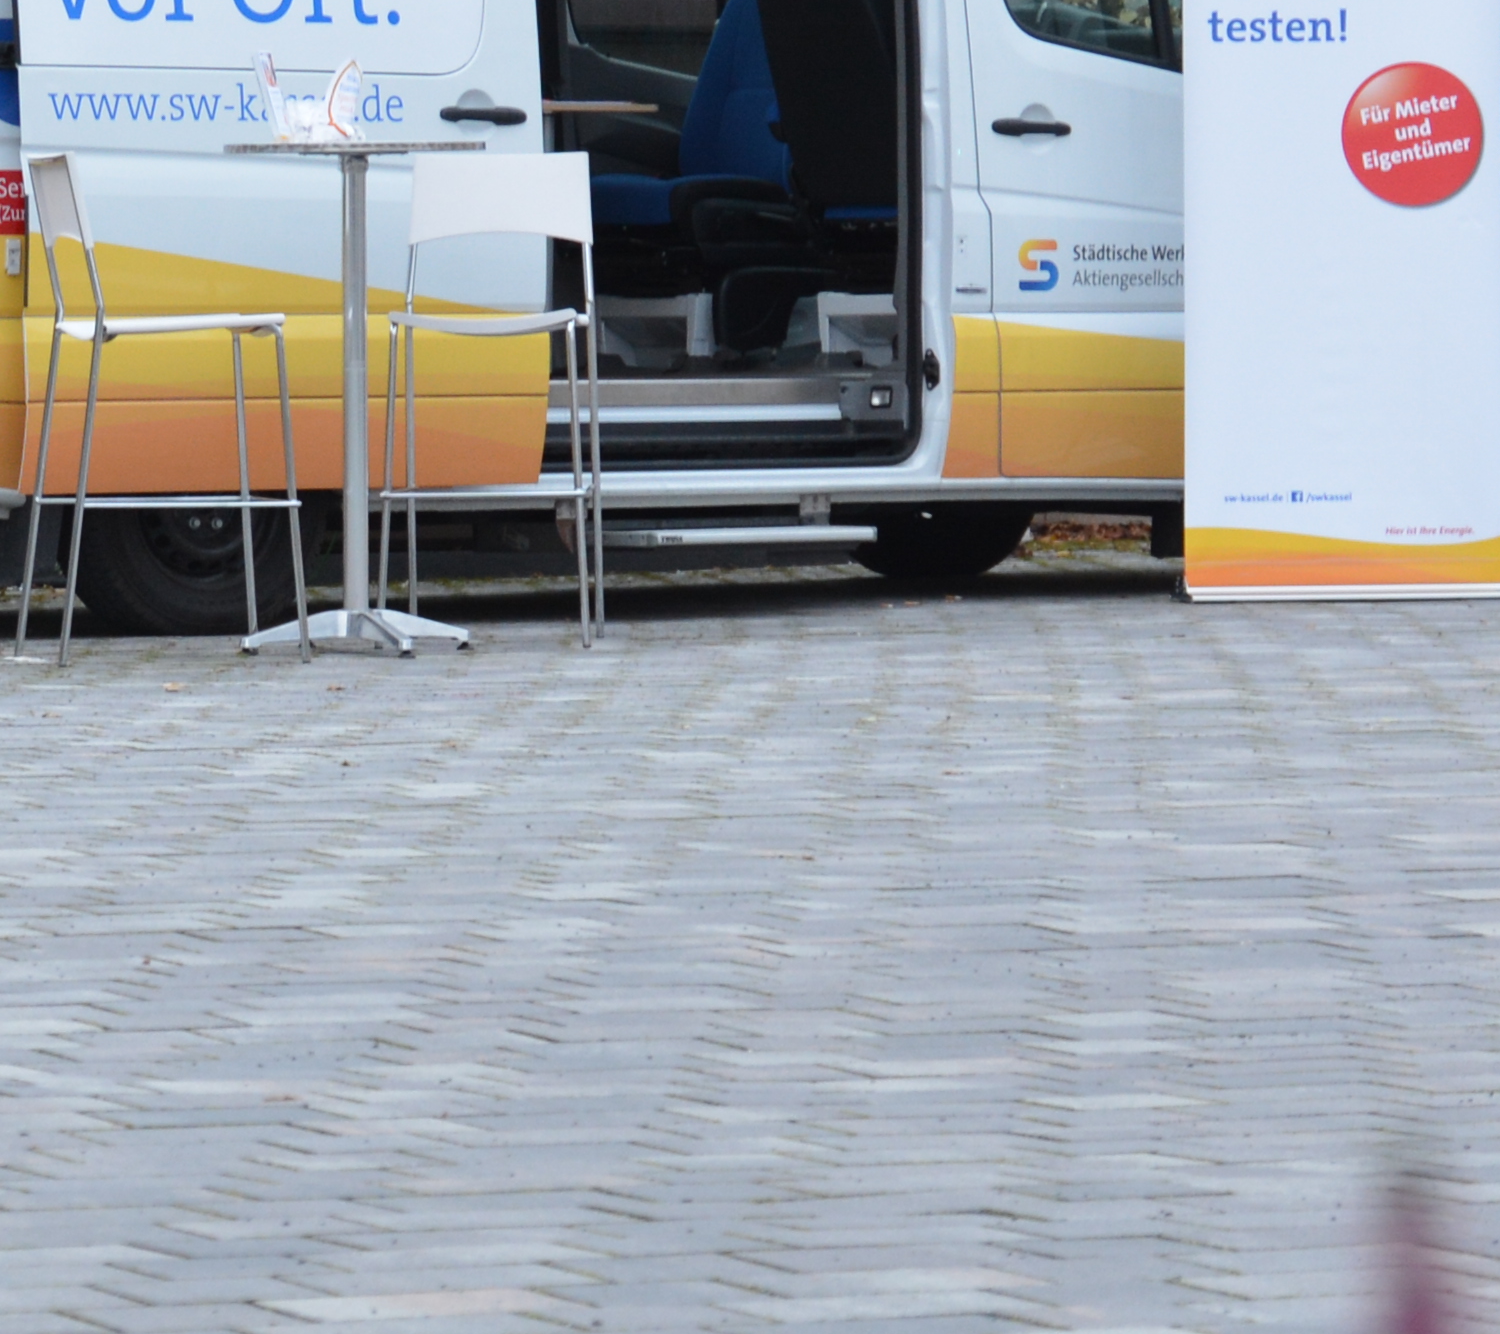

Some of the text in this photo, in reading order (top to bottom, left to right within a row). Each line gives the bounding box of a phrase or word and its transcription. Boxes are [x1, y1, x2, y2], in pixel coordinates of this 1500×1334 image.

[1207, 8, 1348, 43] testen!
[48, 83, 404, 122] www.sw-k.de
[1360, 94, 1458, 126] Für Mieter
[1394, 117, 1432, 142] und
[1361, 136, 1471, 172] Eigentümer
[1073, 244, 1148, 261] Städtische
